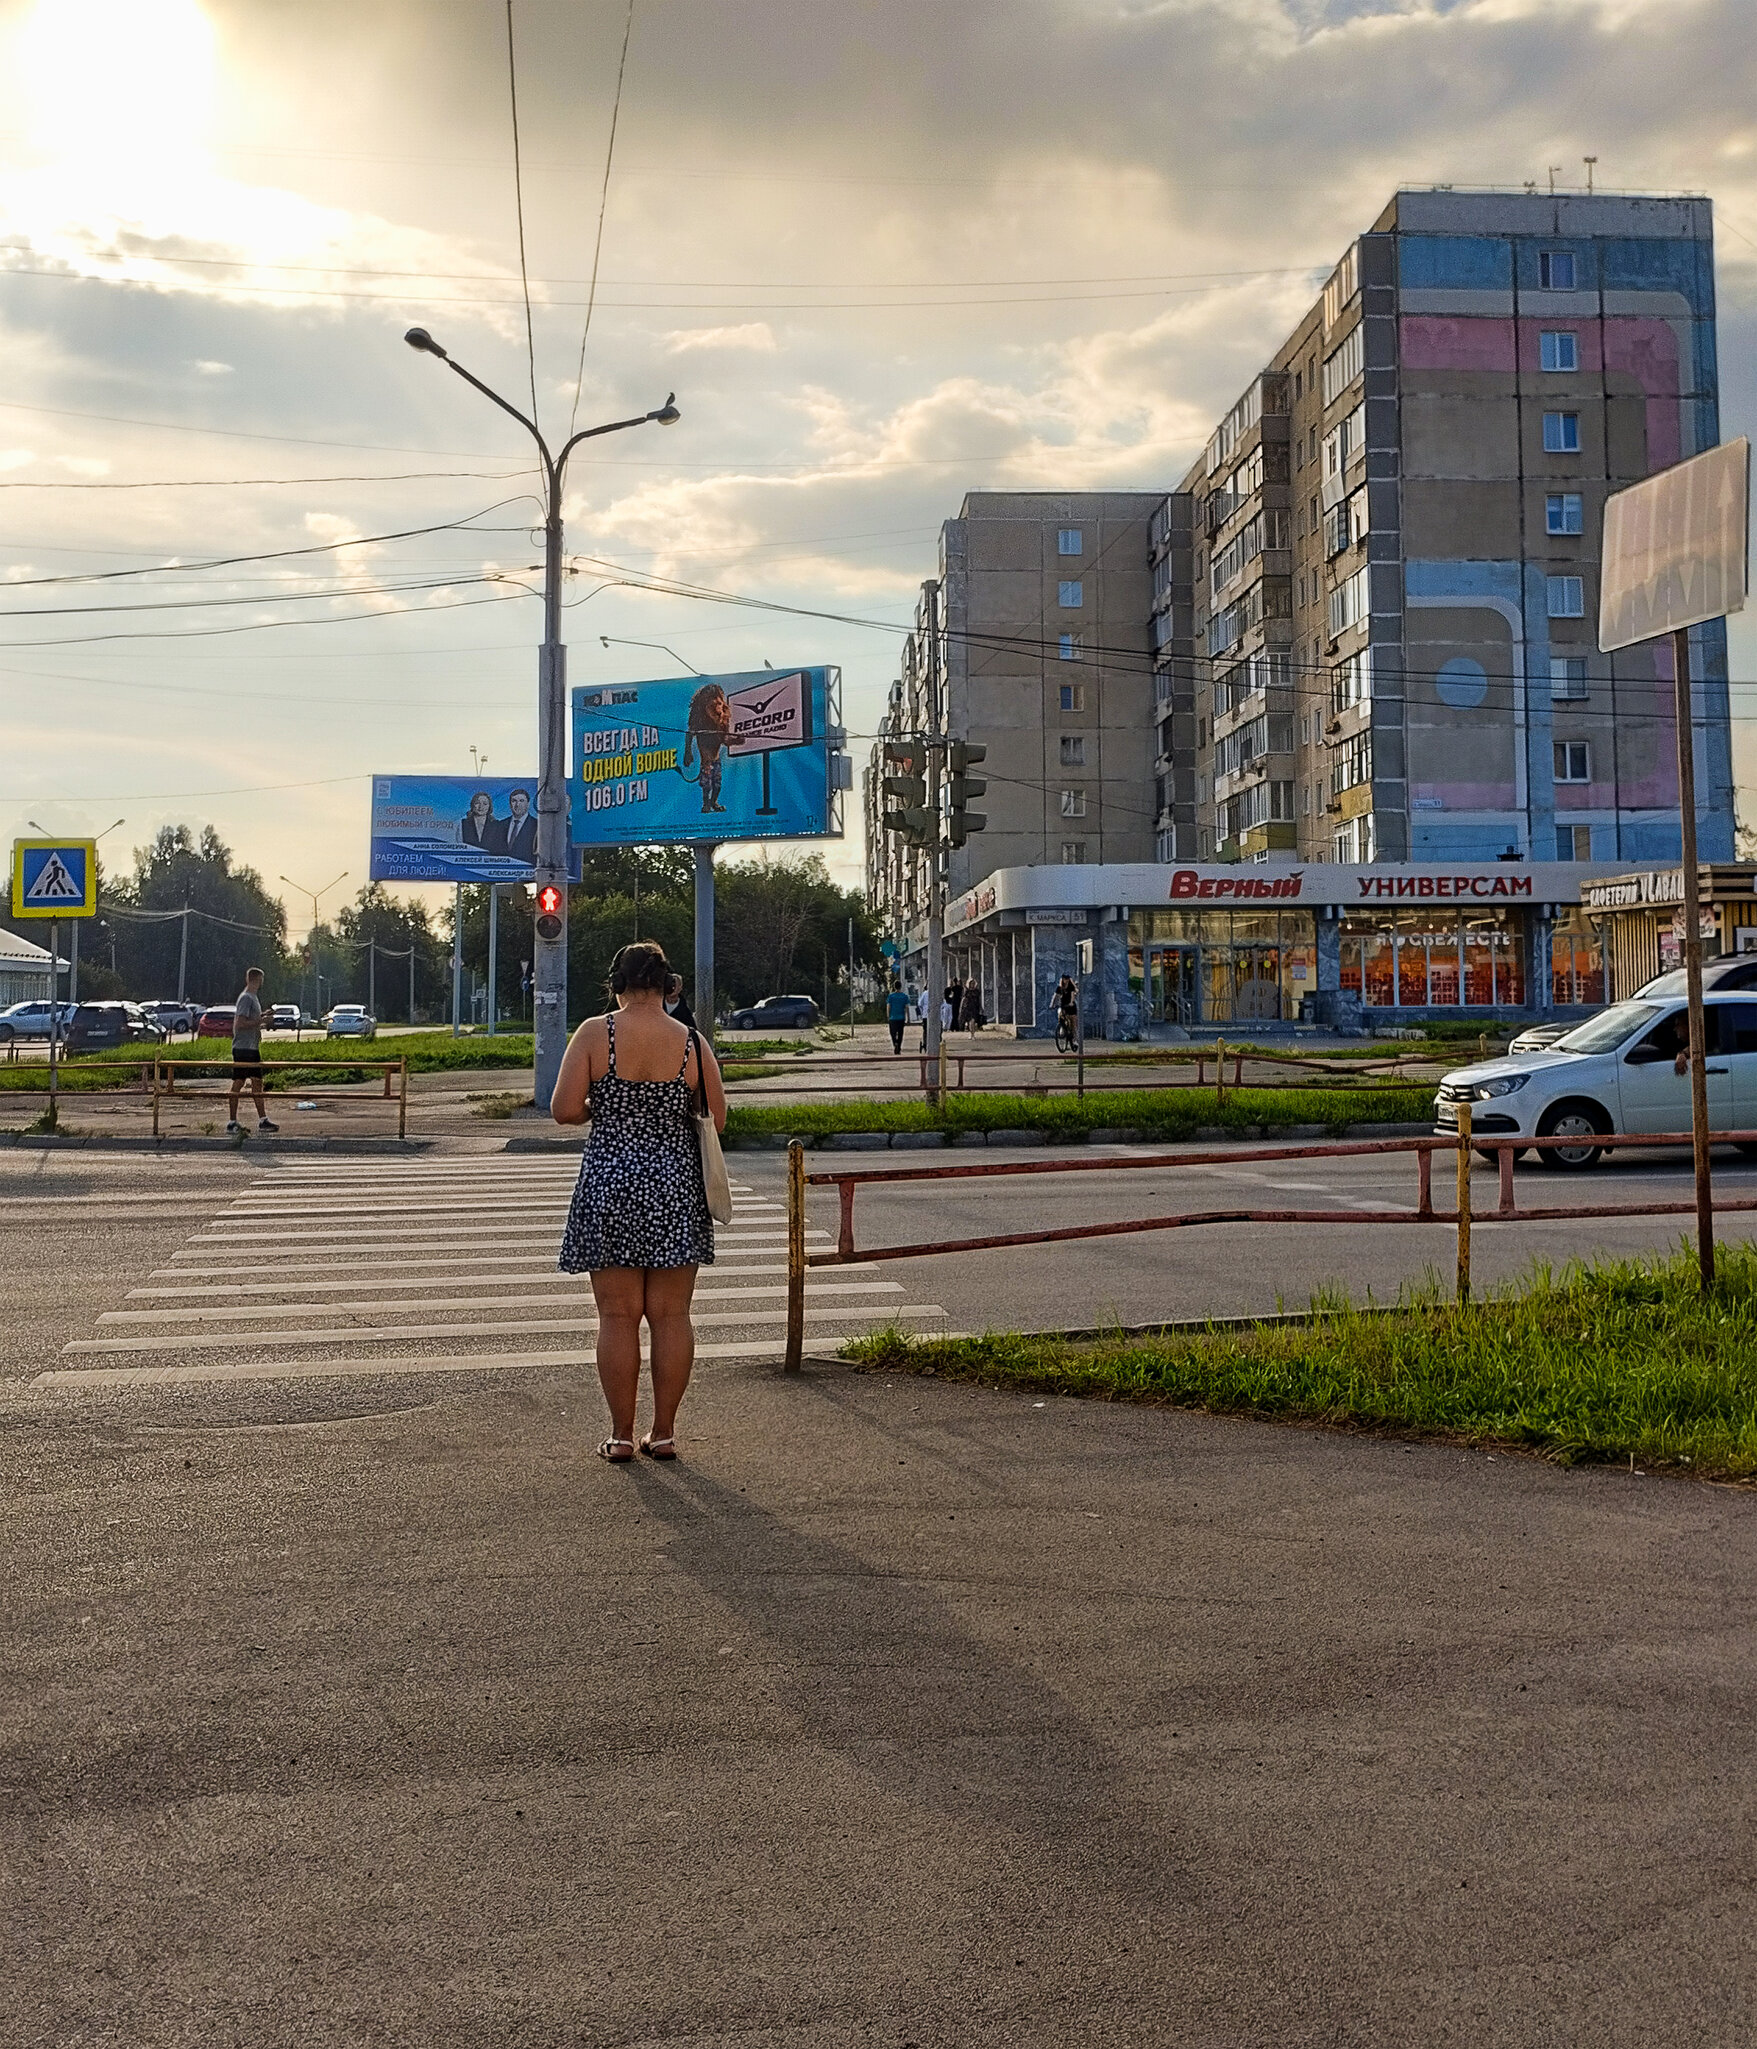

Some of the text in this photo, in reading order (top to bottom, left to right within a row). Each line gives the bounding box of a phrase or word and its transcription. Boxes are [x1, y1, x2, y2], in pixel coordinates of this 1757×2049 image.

[734, 708, 796, 733] RECORD
[764, 724, 787, 734] RADIO
[583, 726, 659, 755] ВСЕГДА НА
[582, 748, 677, 785] ОДНОЙ ВОЛНЕ
[584, 779, 649, 813] 106.0 FM
[386, 806, 434, 816] ЮБИЛЕЕМ
[376, 818, 454, 830] ЛЮБИМЫЙ ГОРОД
[375, 853, 424, 863] РАБОТАЕМ
[388, 864, 448, 876] ДЛЯ ЛЮДЕЙ!
[1357, 876, 1532, 897] УНИВЕРСАМ
[1589, 877, 1637, 907] КАФЕТЕРИЙ
